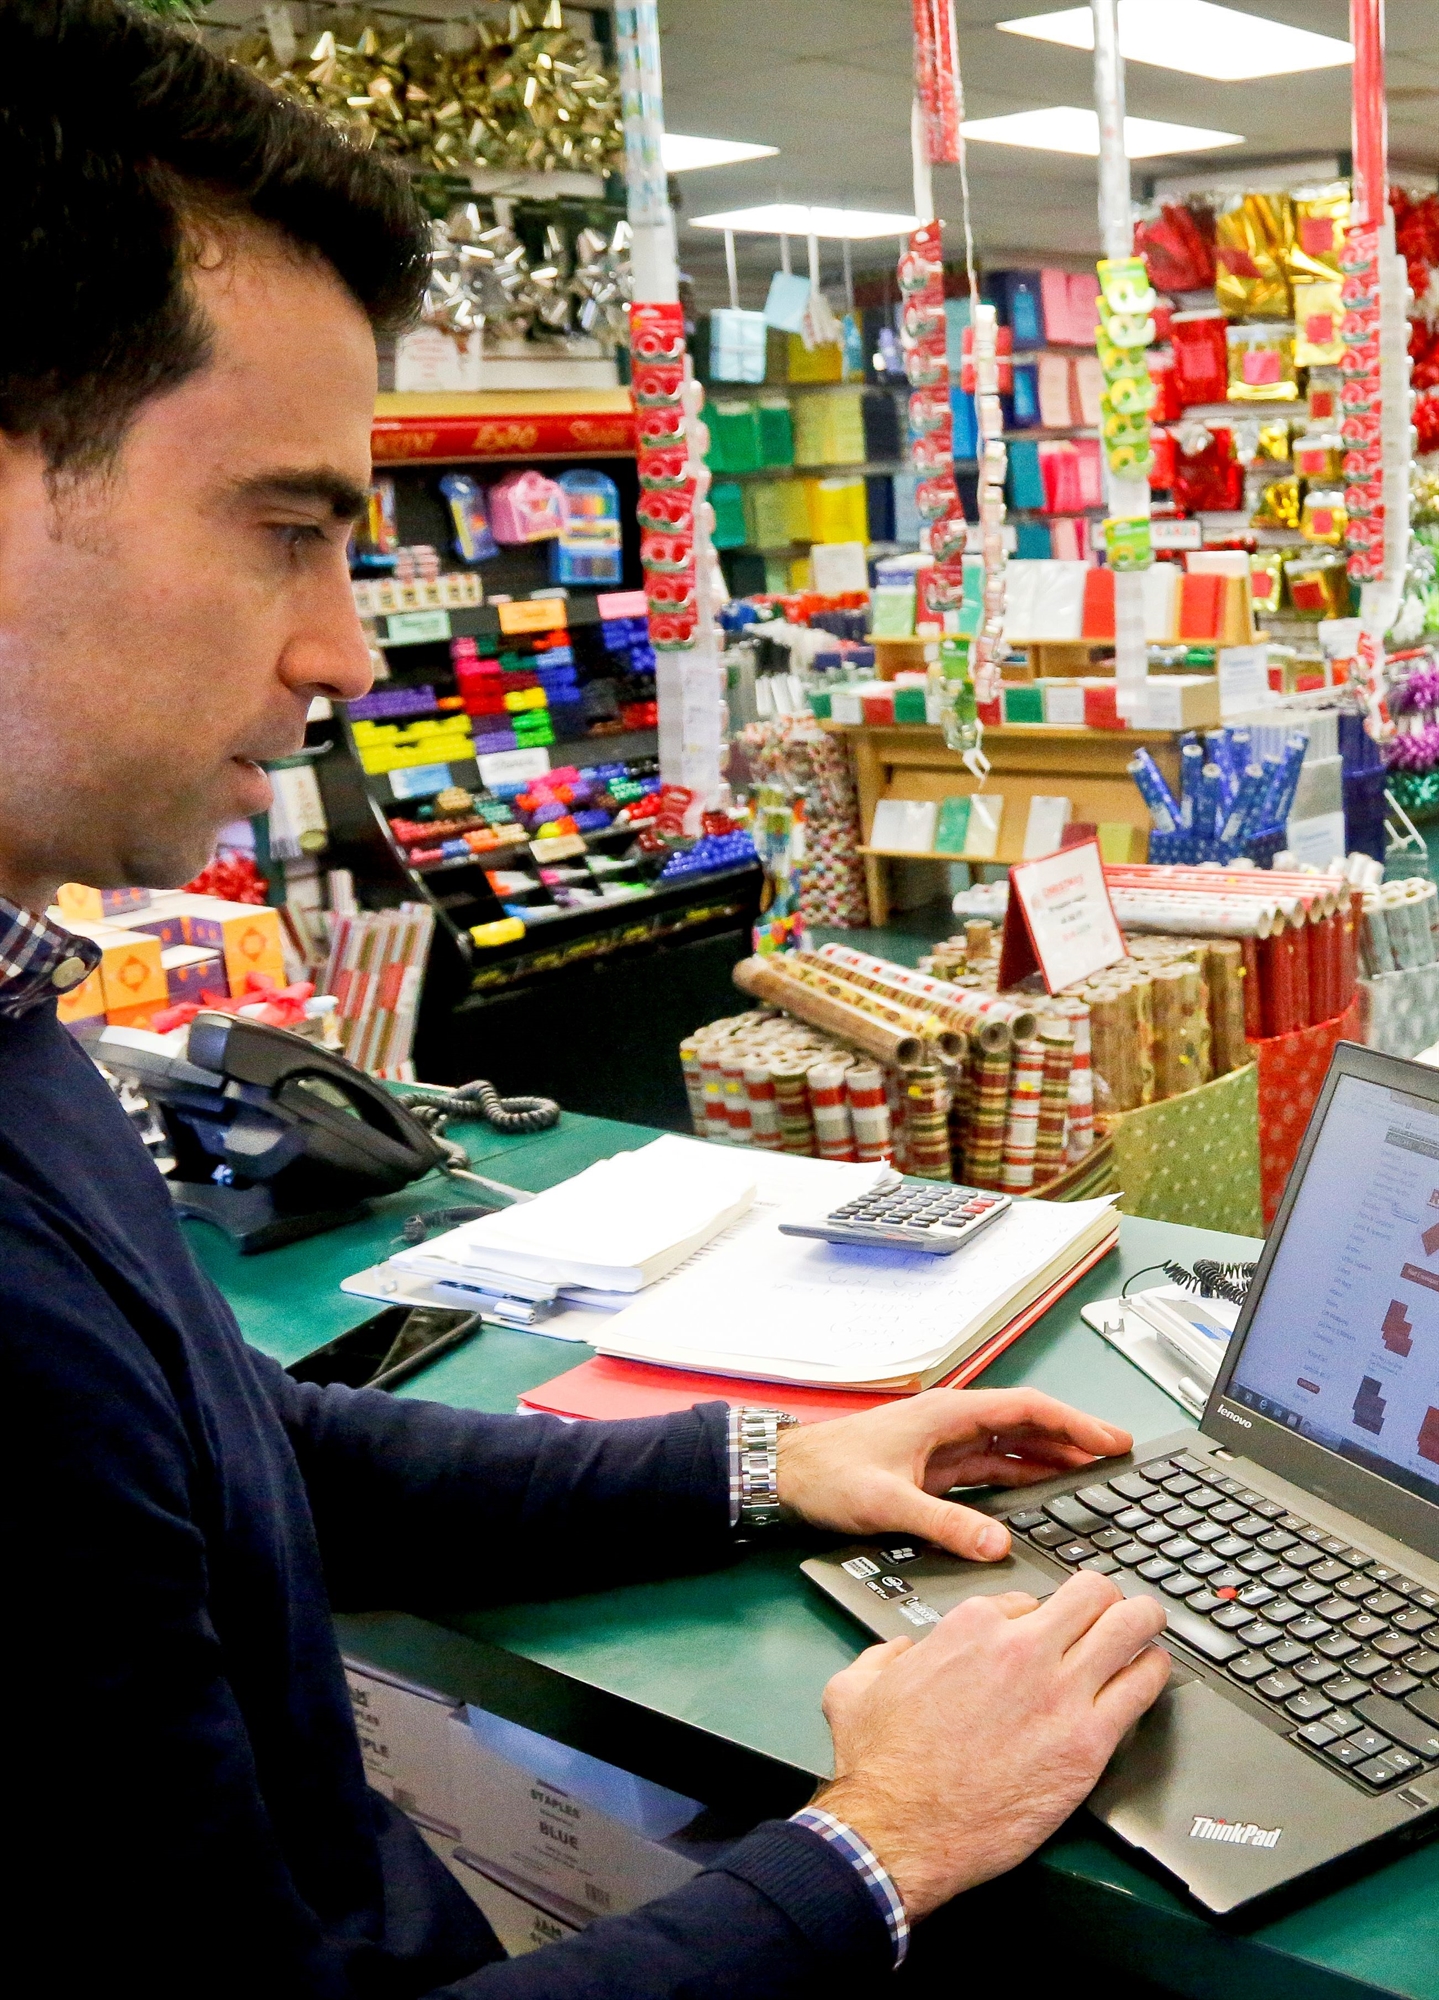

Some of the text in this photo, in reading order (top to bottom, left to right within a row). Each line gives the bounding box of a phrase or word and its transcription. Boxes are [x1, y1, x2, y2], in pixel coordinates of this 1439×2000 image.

[1216, 1403, 1253, 1430] lenovo
[1177, 1508, 1192, 1516] W
[1200, 1522, 1213, 1530] E
[1104, 1529, 1117, 1537] Z
[1224, 1537, 1237, 1545] R
[1127, 1544, 1140, 1552] X
[1196, 1553, 1209, 1561] F
[1251, 1551, 1263, 1559] T
[1151, 1559, 1163, 1567] C
[1223, 1570, 1235, 1578] G
[1277, 1566, 1290, 1574] Y
[1302, 1582, 1315, 1590] U
[1196, 1591, 1209, 1599] B
[1225, 1605, 1241, 1615] N
[1300, 1616, 1315, 1625] K
[1358, 1615, 1371, 1624] O
[1252, 1622, 1267, 1632] M
[1329, 1634, 1340, 1643] L
[1385, 1631, 1399, 1639] P
[1297, 1696, 1312, 1706] Ctrl
[539, 1820, 580, 1851] BLUE
[1190, 1815, 1282, 1848] ThinkPad
